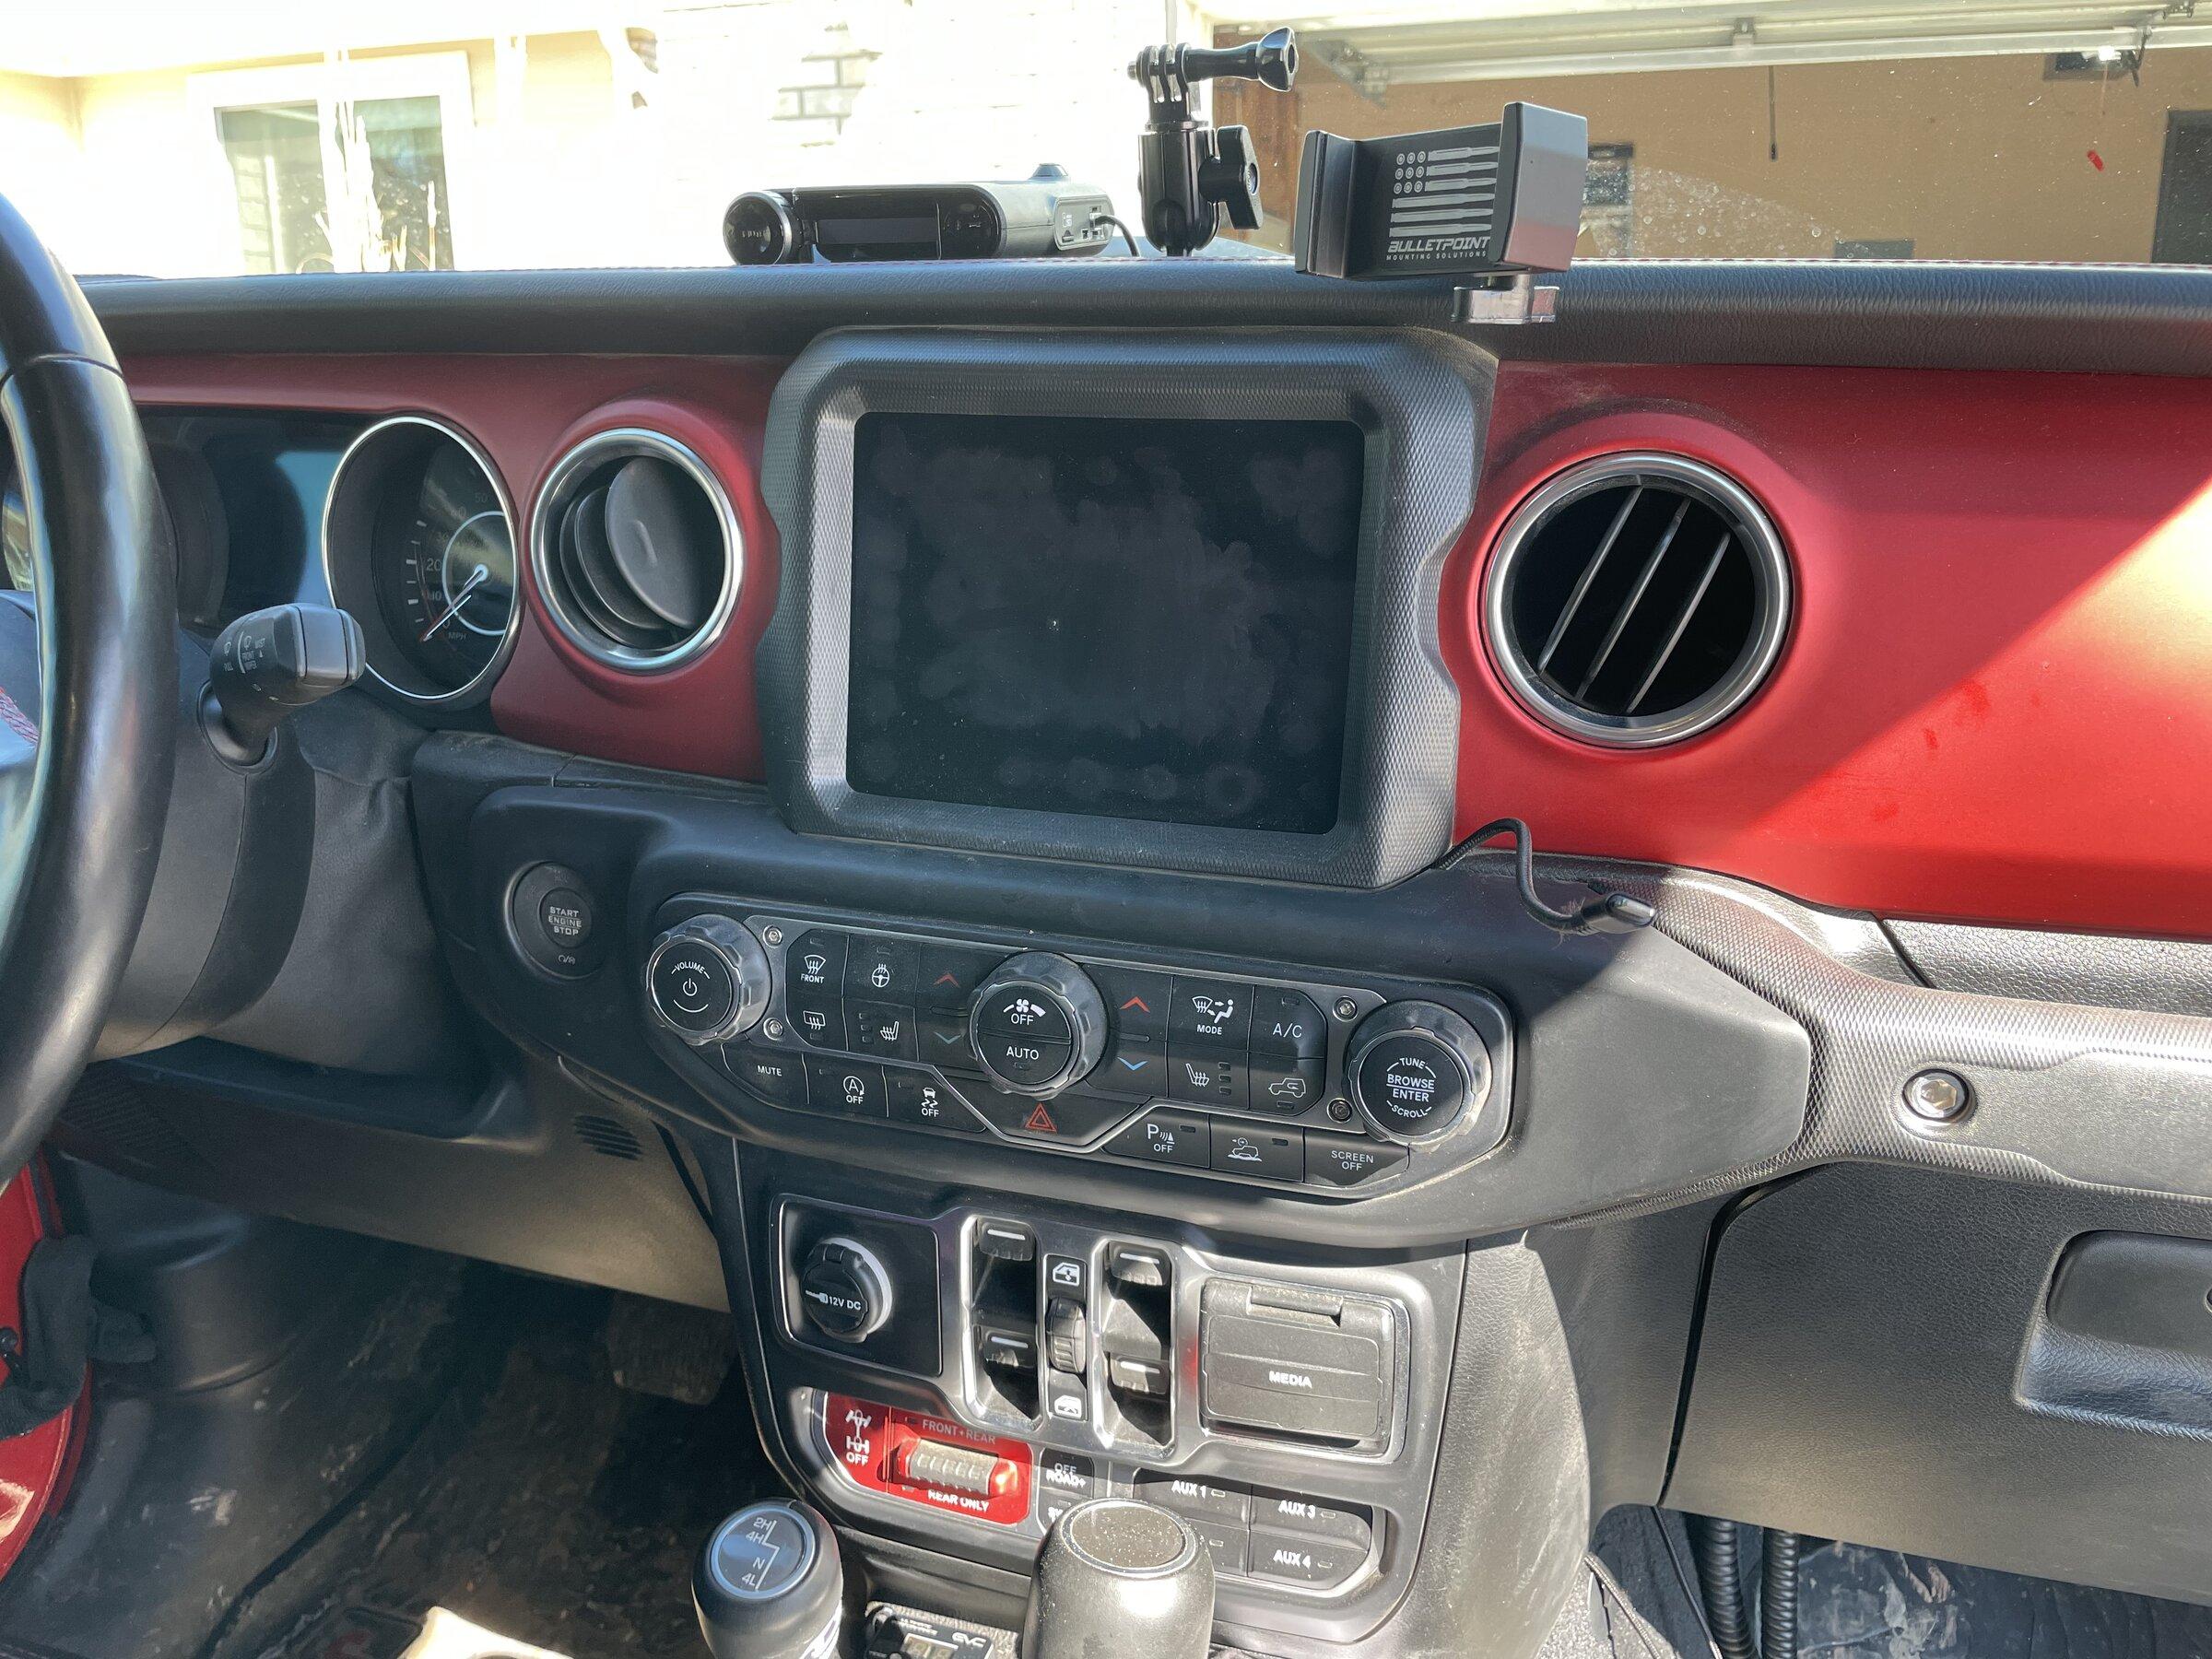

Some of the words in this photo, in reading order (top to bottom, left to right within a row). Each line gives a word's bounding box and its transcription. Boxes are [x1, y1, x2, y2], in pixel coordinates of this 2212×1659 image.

[1388, 236, 1490, 253] BULLETPOINT
[1436, 250, 1487, 259] SOLUTIONS
[427, 558, 442, 571] 20
[448, 631, 466, 640] MPH
[550, 906, 580, 917] START
[548, 915, 582, 927] ENGINE
[554, 925, 579, 935] STOP
[675, 960, 705, 974] VOLUME
[801, 973, 825, 983] FRONT
[1011, 1013, 1034, 1026] OFF
[1197, 1024, 1223, 1035] MODE
[1272, 1022, 1303, 1039] A/C
[1006, 1046, 1039, 1060] AUTO
[1399, 1057, 1426, 1069] TUNE
[757, 1065, 782, 1077] MUTE
[1387, 1073, 1434, 1089] BROWSE
[845, 1094, 864, 1105] OFF
[1392, 1088, 1430, 1102] ENTER
[922, 1107, 940, 1118] OFF
[1391, 1104, 1429, 1118] SCROLL
[1153, 1143, 1173, 1154] OFF
[1331, 1148, 1374, 1165] SCREEN
[1341, 1160, 1362, 1171] OFF
[830, 1296, 845, 1307] 12V
[847, 1300, 861, 1311] DC
[1268, 1371, 1312, 1388] MEDIA
[846, 1452, 868, 1466] OFF
[1054, 1463, 1077, 1474] OFF
[1171, 1480, 1197, 1497] AUX
[1200, 1485, 1206, 1499] 1
[928, 1488, 959, 1506] REAR
[959, 1497, 989, 1512] ONLY
[1278, 1500, 1306, 1518] AUX
[1307, 1504, 1316, 1519] 3
[753, 1517, 771, 1530] 2H
[746, 1530, 764, 1545] 4H
[753, 1557, 765, 1570] N
[1273, 1549, 1300, 1568] AUX
[1302, 1555, 1311, 1570] 4
[742, 1572, 756, 1586] 4L
